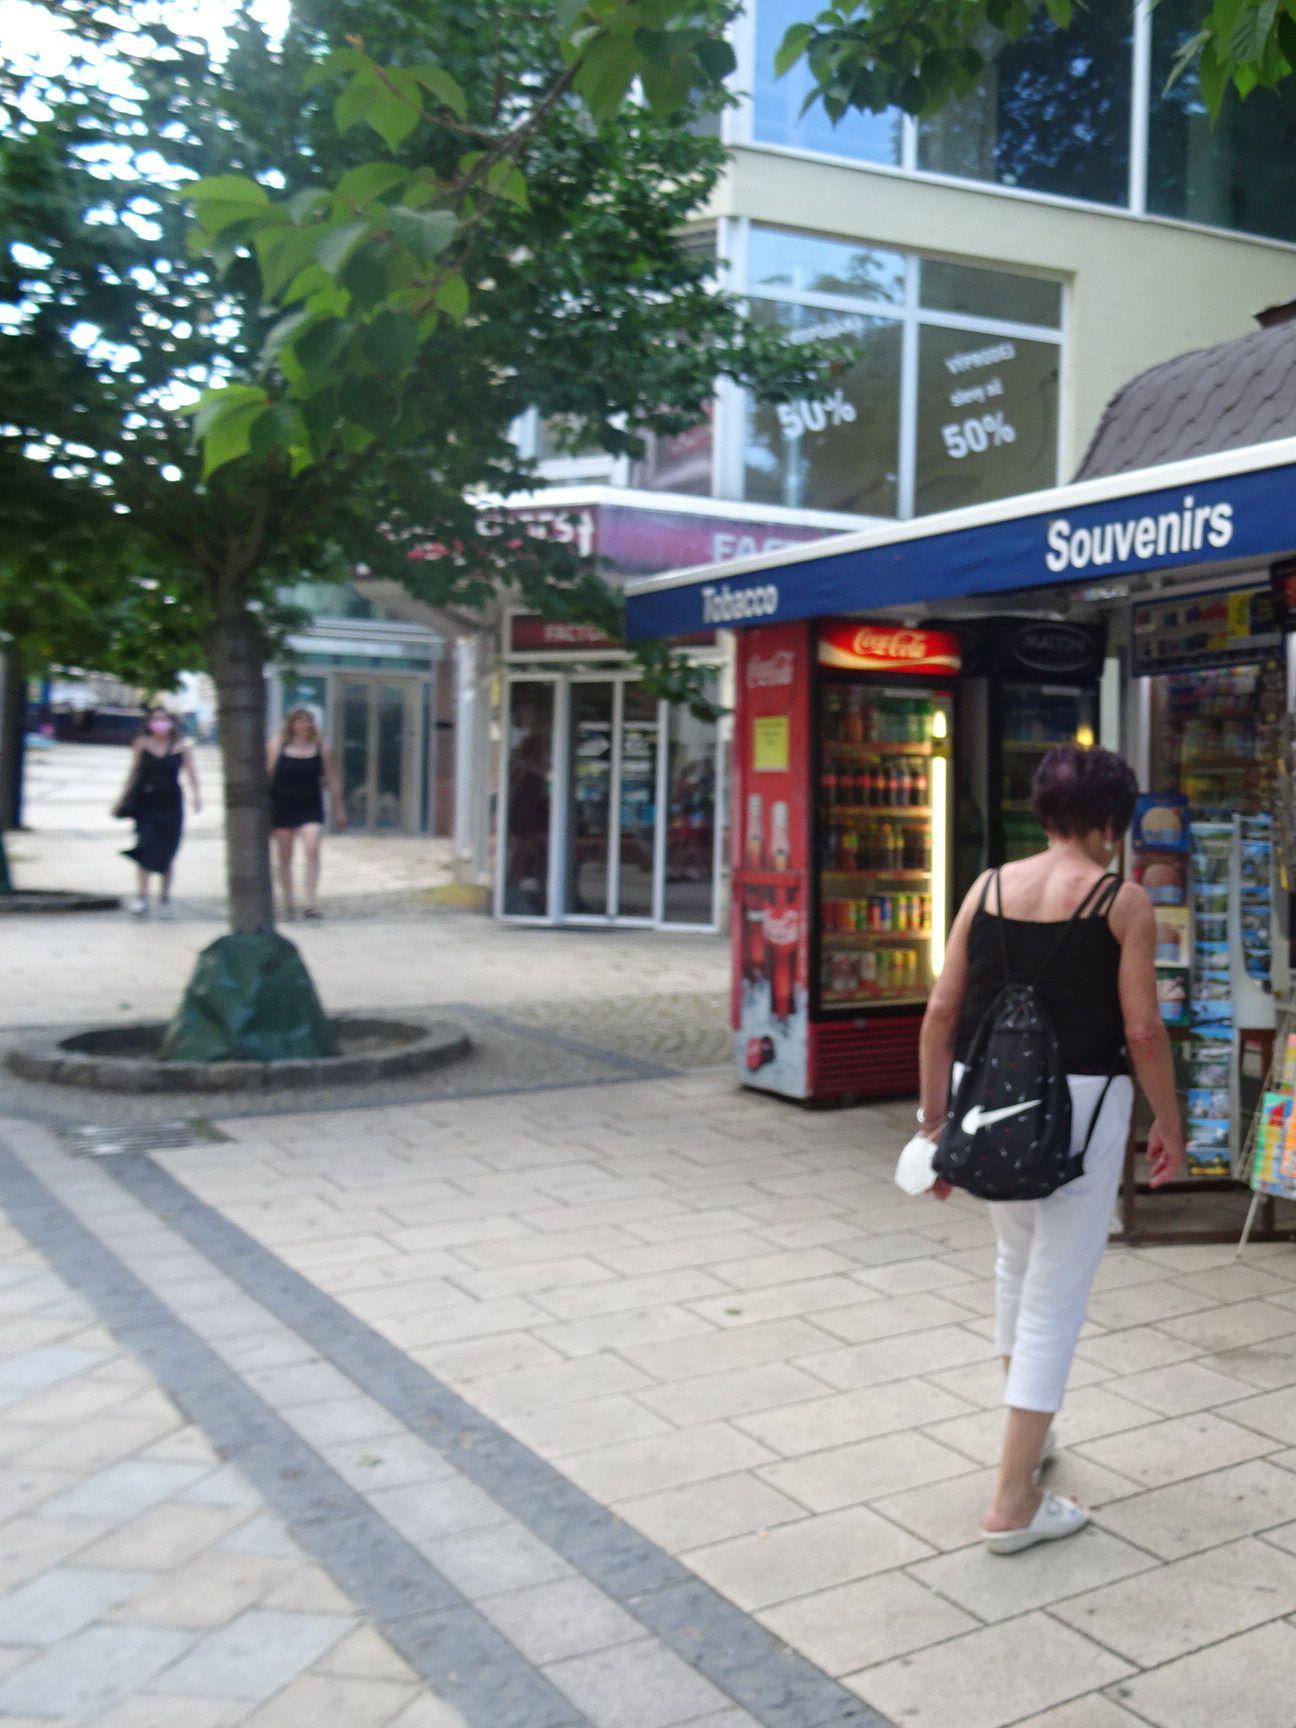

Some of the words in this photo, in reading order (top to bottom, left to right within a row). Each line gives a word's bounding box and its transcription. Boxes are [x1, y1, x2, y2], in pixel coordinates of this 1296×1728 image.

[941, 409, 1017, 459] 50%
[1045, 494, 1235, 573] Souvenirs
[702, 583, 779, 624] Tobacco
